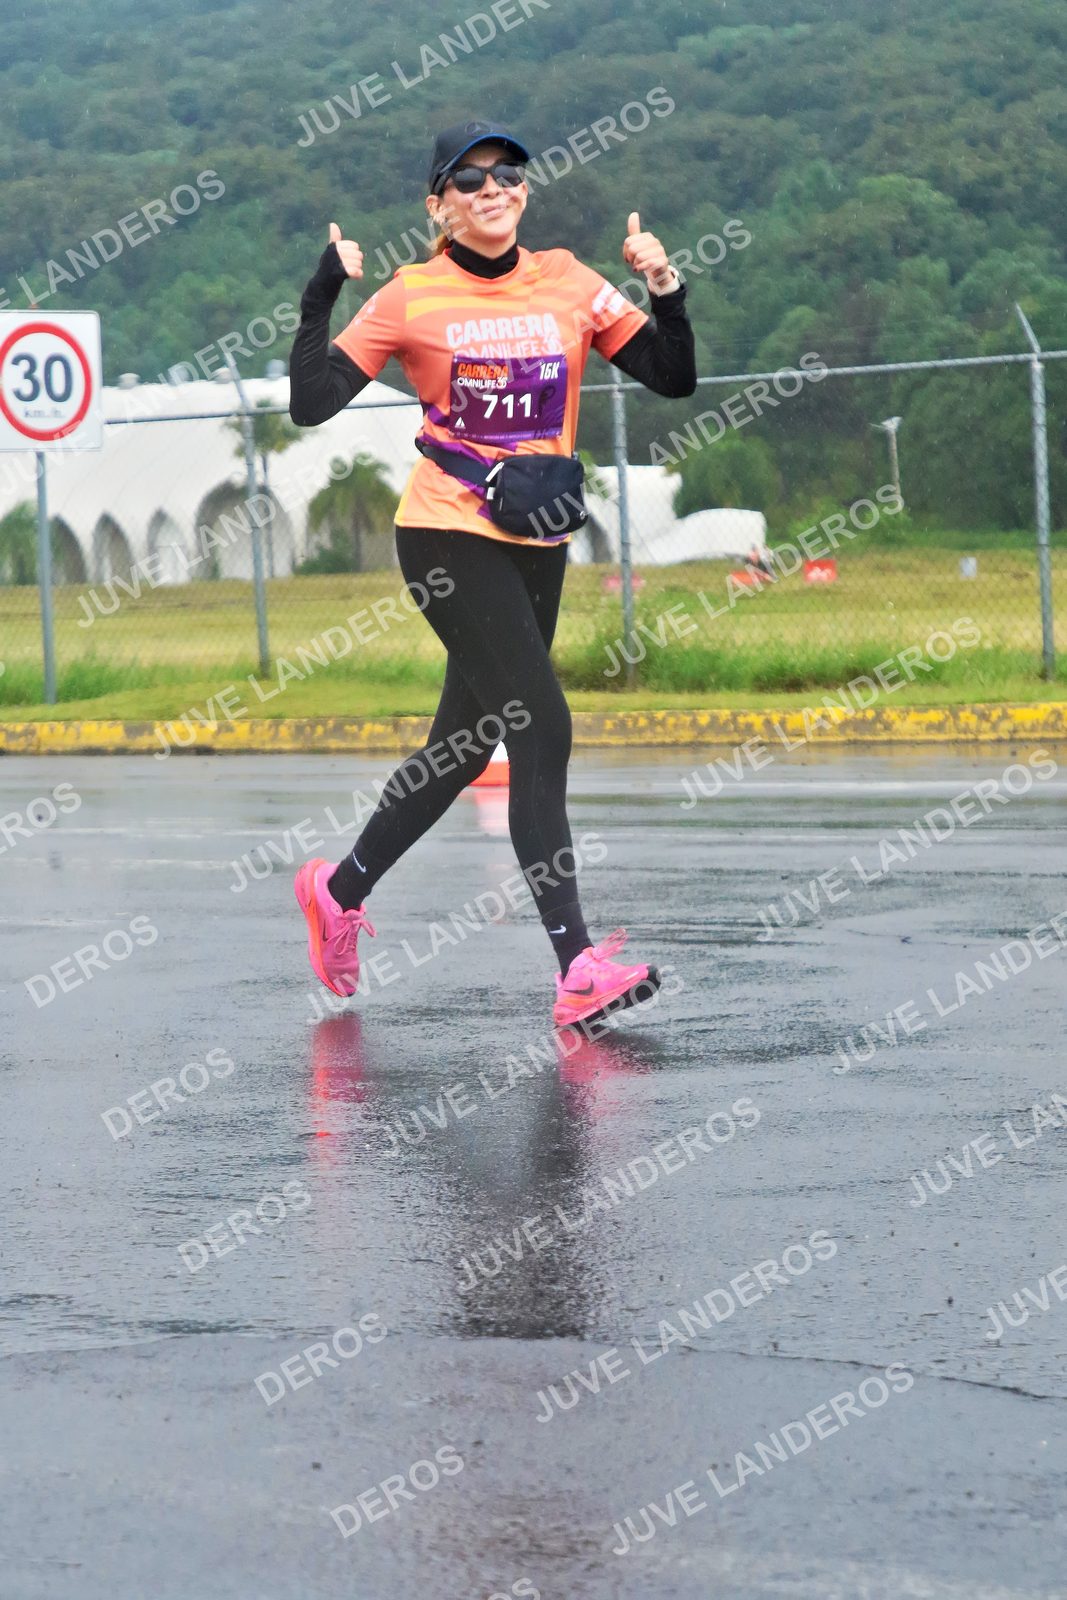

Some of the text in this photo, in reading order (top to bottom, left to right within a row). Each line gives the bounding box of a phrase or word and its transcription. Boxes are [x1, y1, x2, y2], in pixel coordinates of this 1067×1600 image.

[446, 313, 560, 347] CARRERA
[11, 353, 73, 403] 30
[457, 362, 509, 380] CARRERA
[457, 377, 496, 390] OMNILIFE
[482, 393, 532, 419] 711
